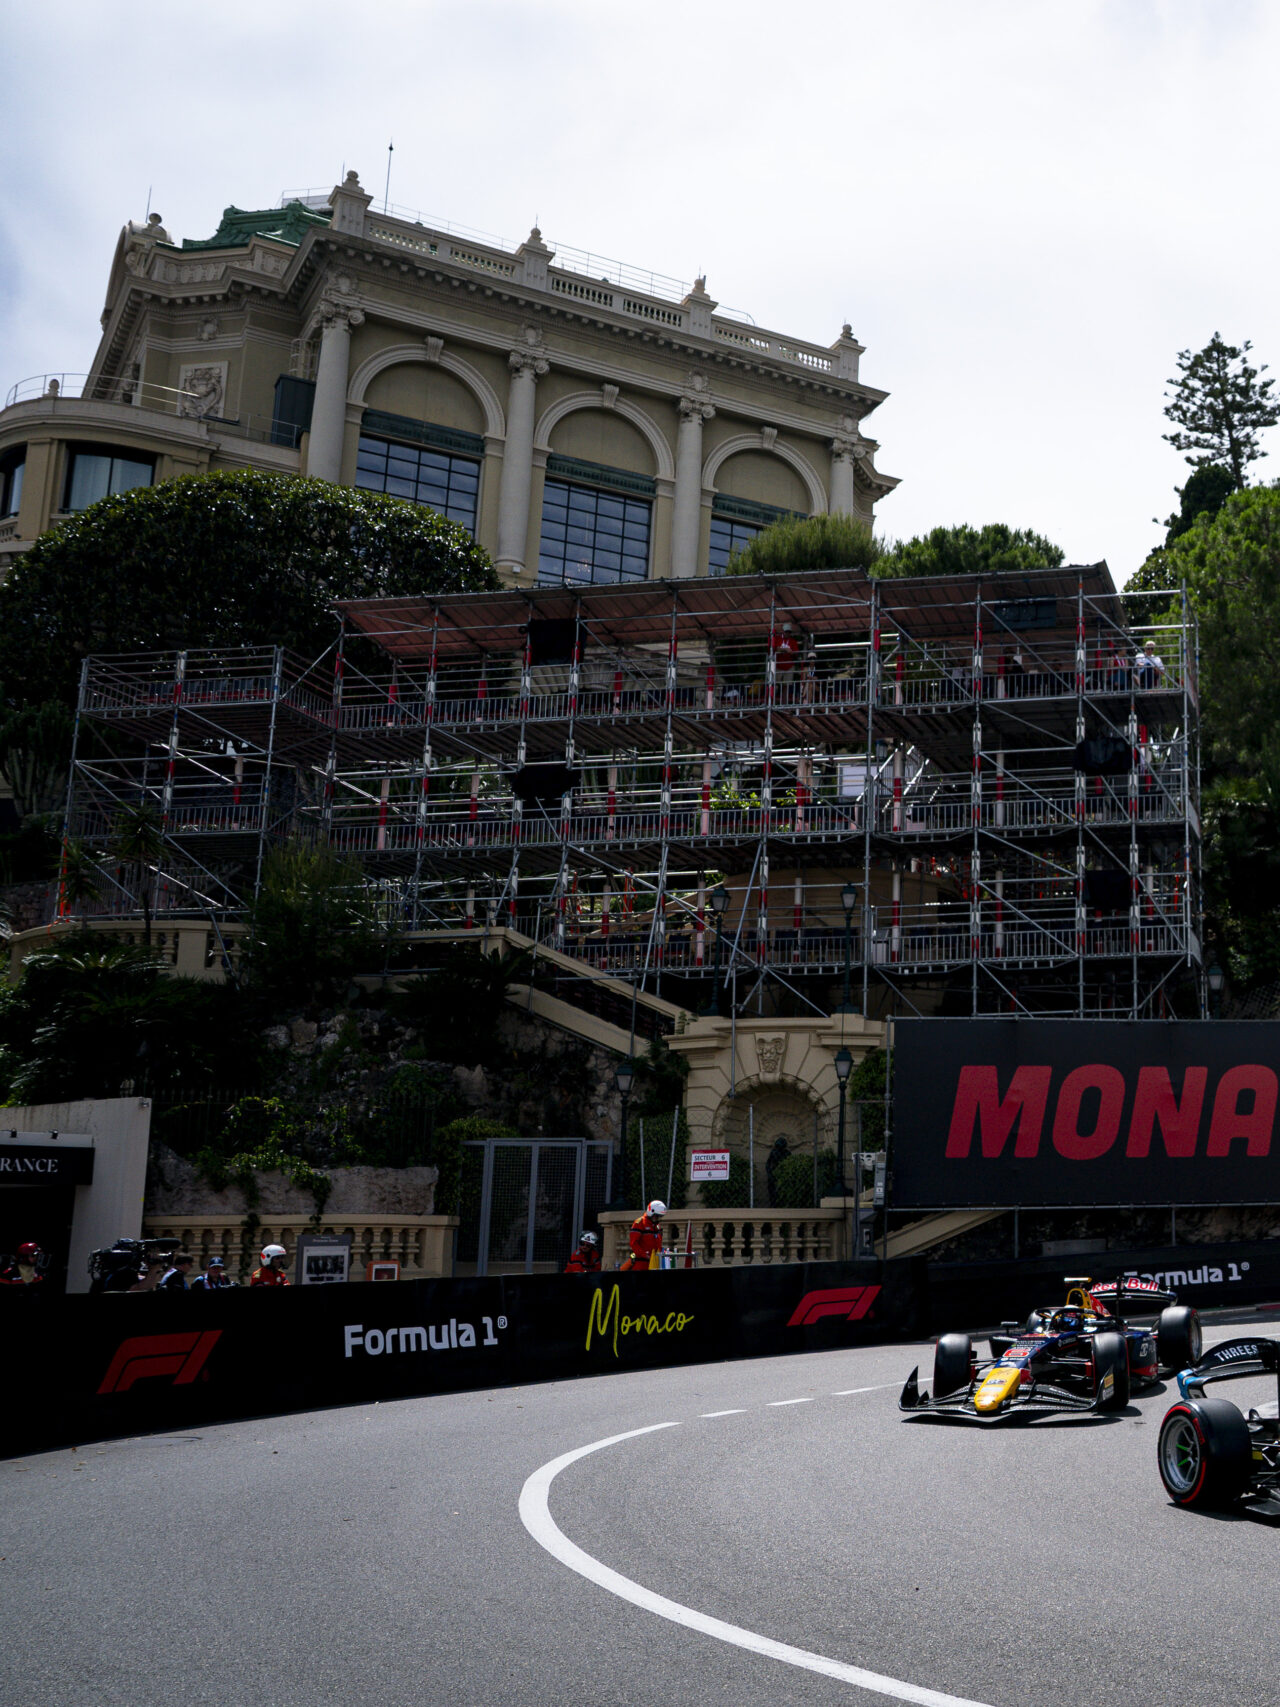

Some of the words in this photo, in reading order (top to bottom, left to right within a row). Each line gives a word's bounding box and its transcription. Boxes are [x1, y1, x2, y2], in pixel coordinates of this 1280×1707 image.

[1127, 1278, 1158, 1291] Bull
[344, 1318, 477, 1358] Formula
[585, 1284, 695, 1358] Monaco
